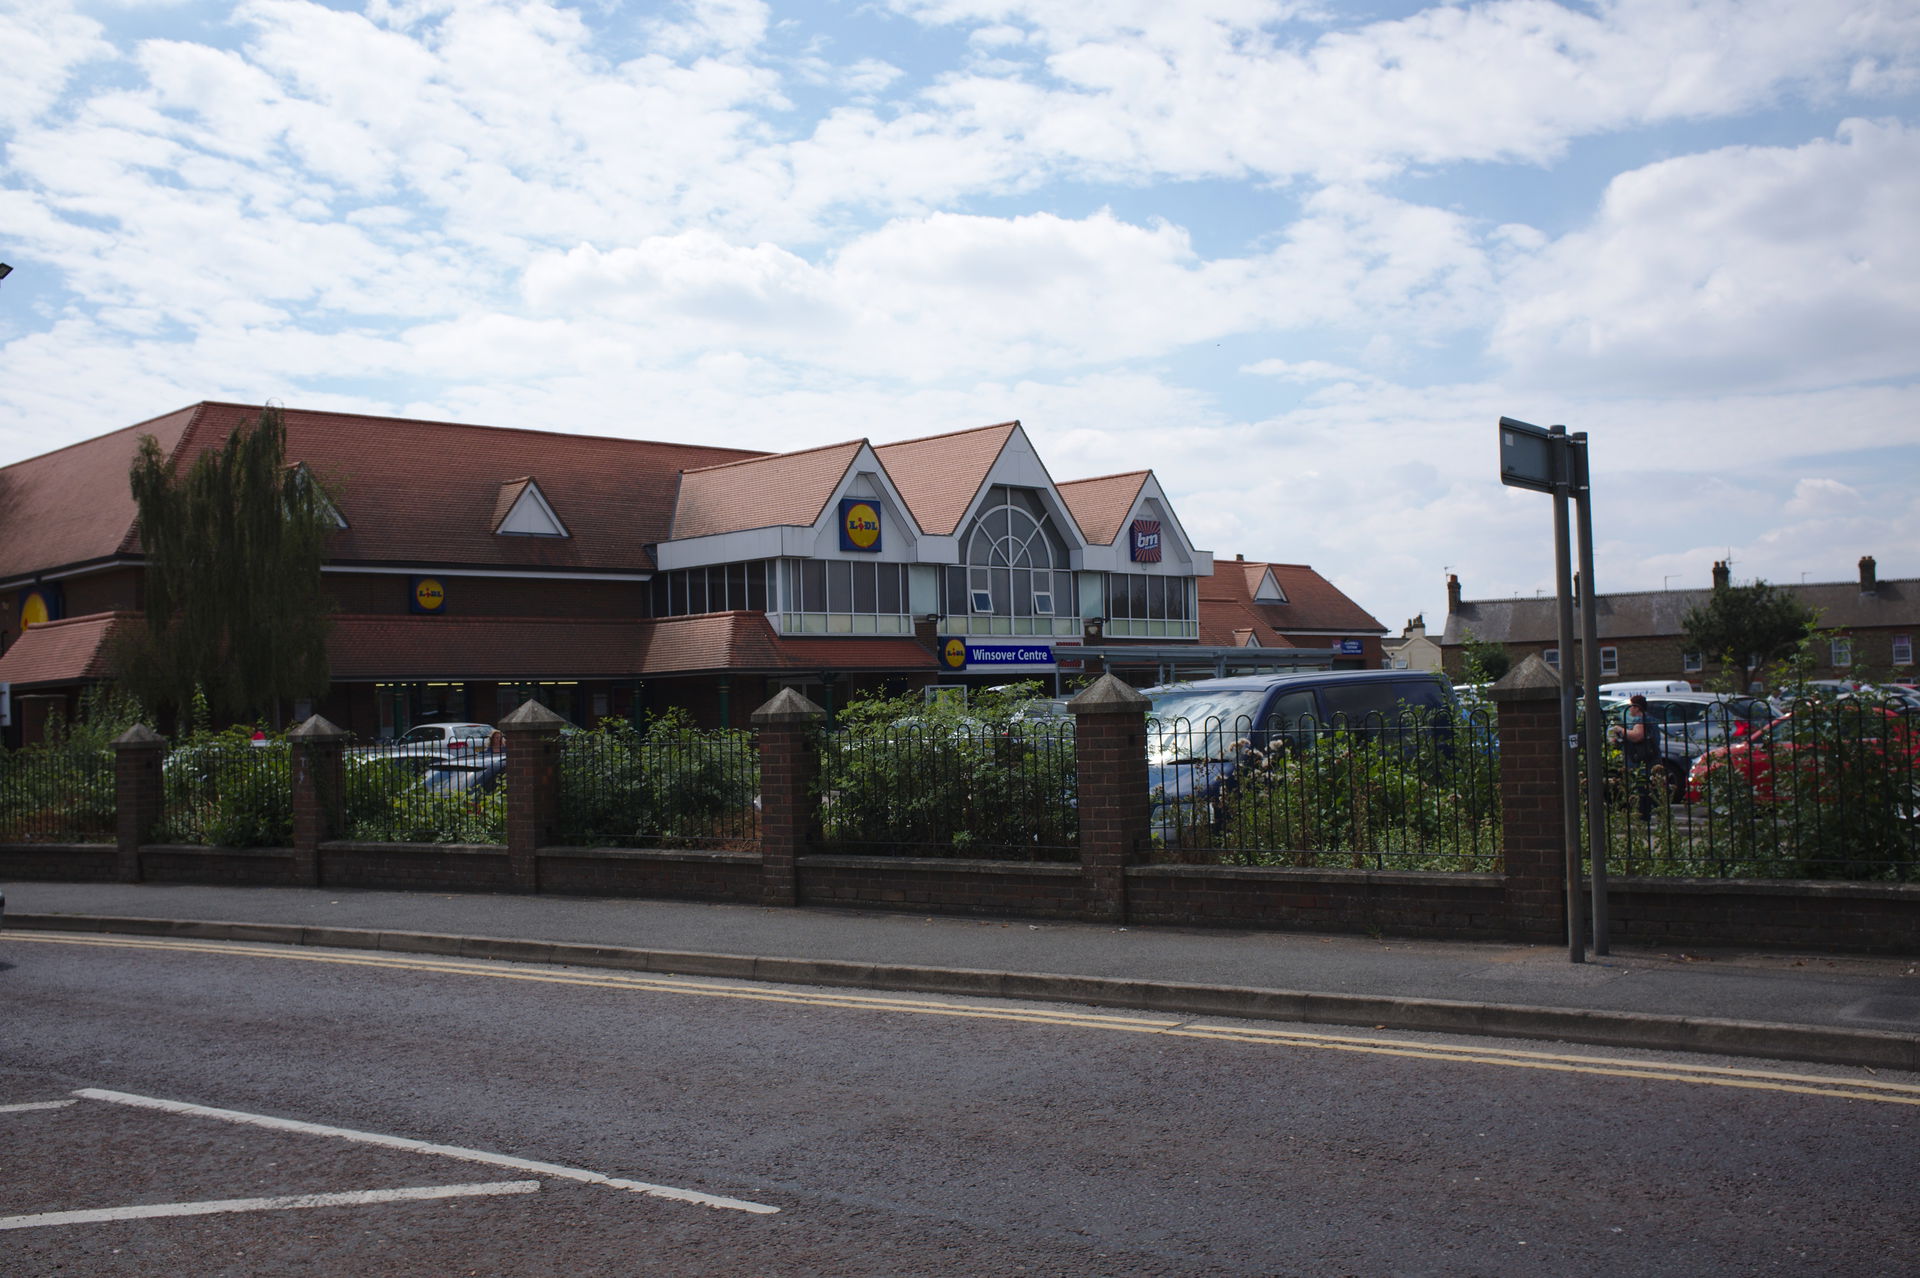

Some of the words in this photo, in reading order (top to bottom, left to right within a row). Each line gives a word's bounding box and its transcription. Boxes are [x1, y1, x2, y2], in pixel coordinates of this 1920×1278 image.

[1137, 532, 1158, 548] bm
[972, 648, 1016, 661] Winsover
[1017, 648, 1048, 661] Centre
